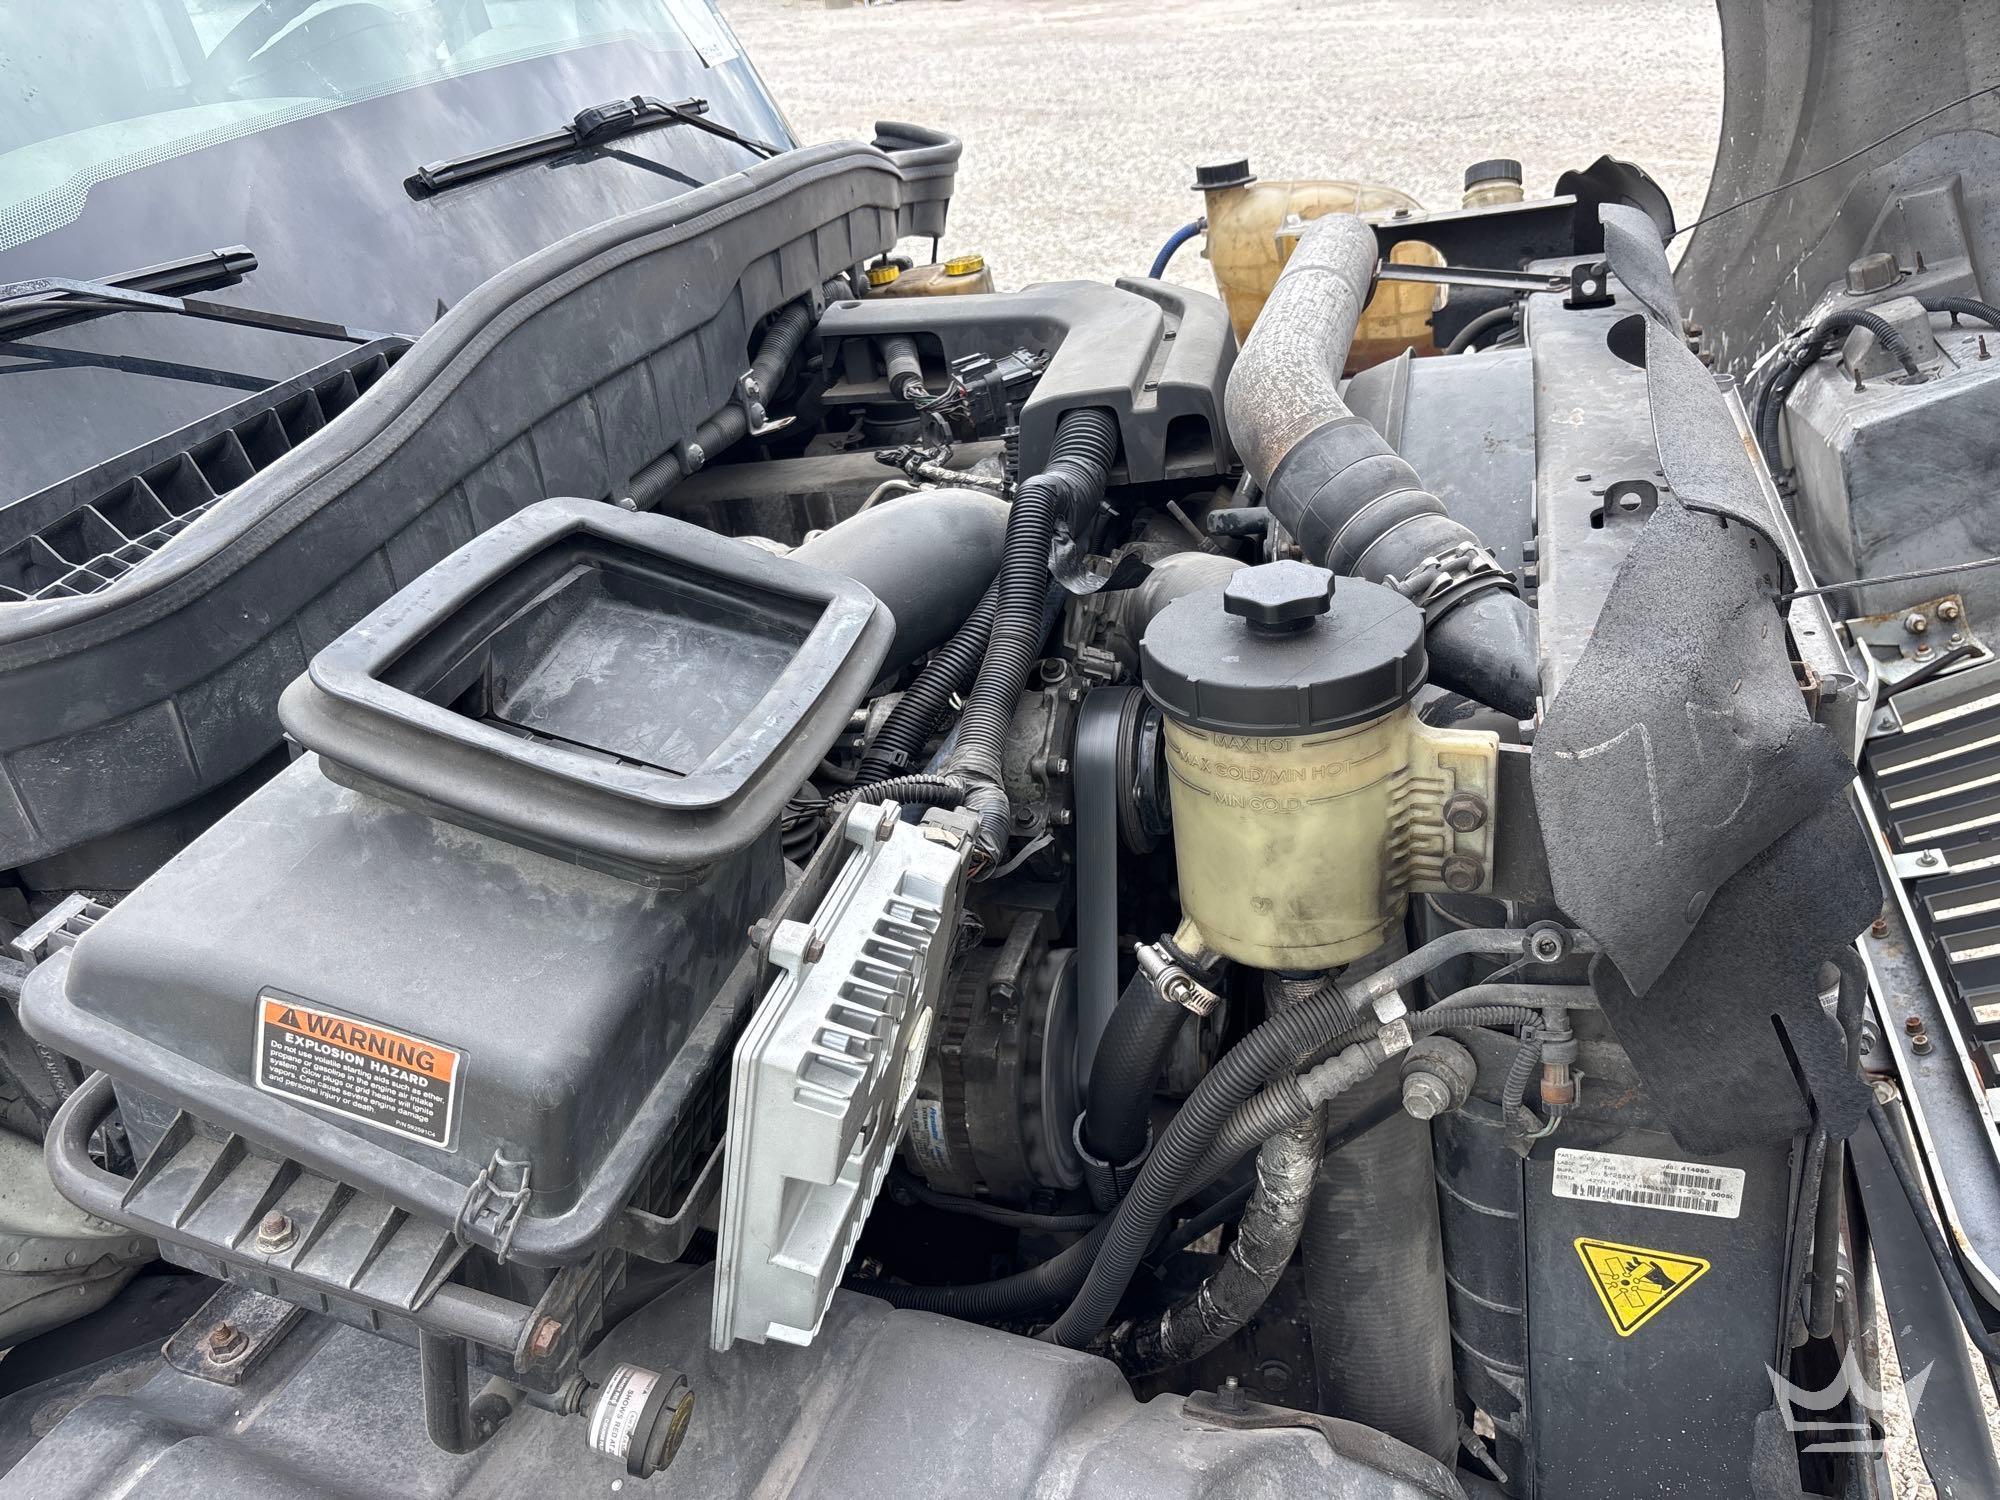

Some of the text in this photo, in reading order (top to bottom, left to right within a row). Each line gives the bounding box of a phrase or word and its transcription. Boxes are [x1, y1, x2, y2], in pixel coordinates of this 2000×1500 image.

[1178, 748, 1352, 785] MAX COLD/MIN HOT
[1213, 733, 1293, 753] MAX HOT
[1213, 791, 1303, 814] MIN COLD
[270, 1039, 282, 1049] Do
[283, 1044, 296, 1053] not
[298, 1049, 312, 1059] use
[314, 1054, 341, 1068] volatile
[342, 1063, 372, 1080] starting
[373, 1073, 389, 1084] aids
[391, 1079, 410, 1091] such
[411, 1087, 421, 1095] as
[285, 1031, 428, 1087] EXPLOSION HAZARD
[306, 1012, 435, 1072] WARNING
[268, 1072, 284, 1083] and
[285, 1077, 318, 1095] personal
[319, 1088, 341, 1103] injury
[342, 1097, 351, 1105] or
[268, 1064, 429, 1124] vapors. Can cause severe engine damage
[269, 1048, 434, 1108] propane or gasoline in the engine air intake
[301, 1065, 321, 1078] Glow
[322, 1073, 343, 1087] plugs
[345, 1081, 353, 1089] or
[354, 1083, 370, 1096] grid
[371, 1089, 397, 1104] heater
[397, 1098, 411, 1108] will
[411, 1103, 434, 1117] ignite
[616, 1388, 634, 1421] SHOWS
